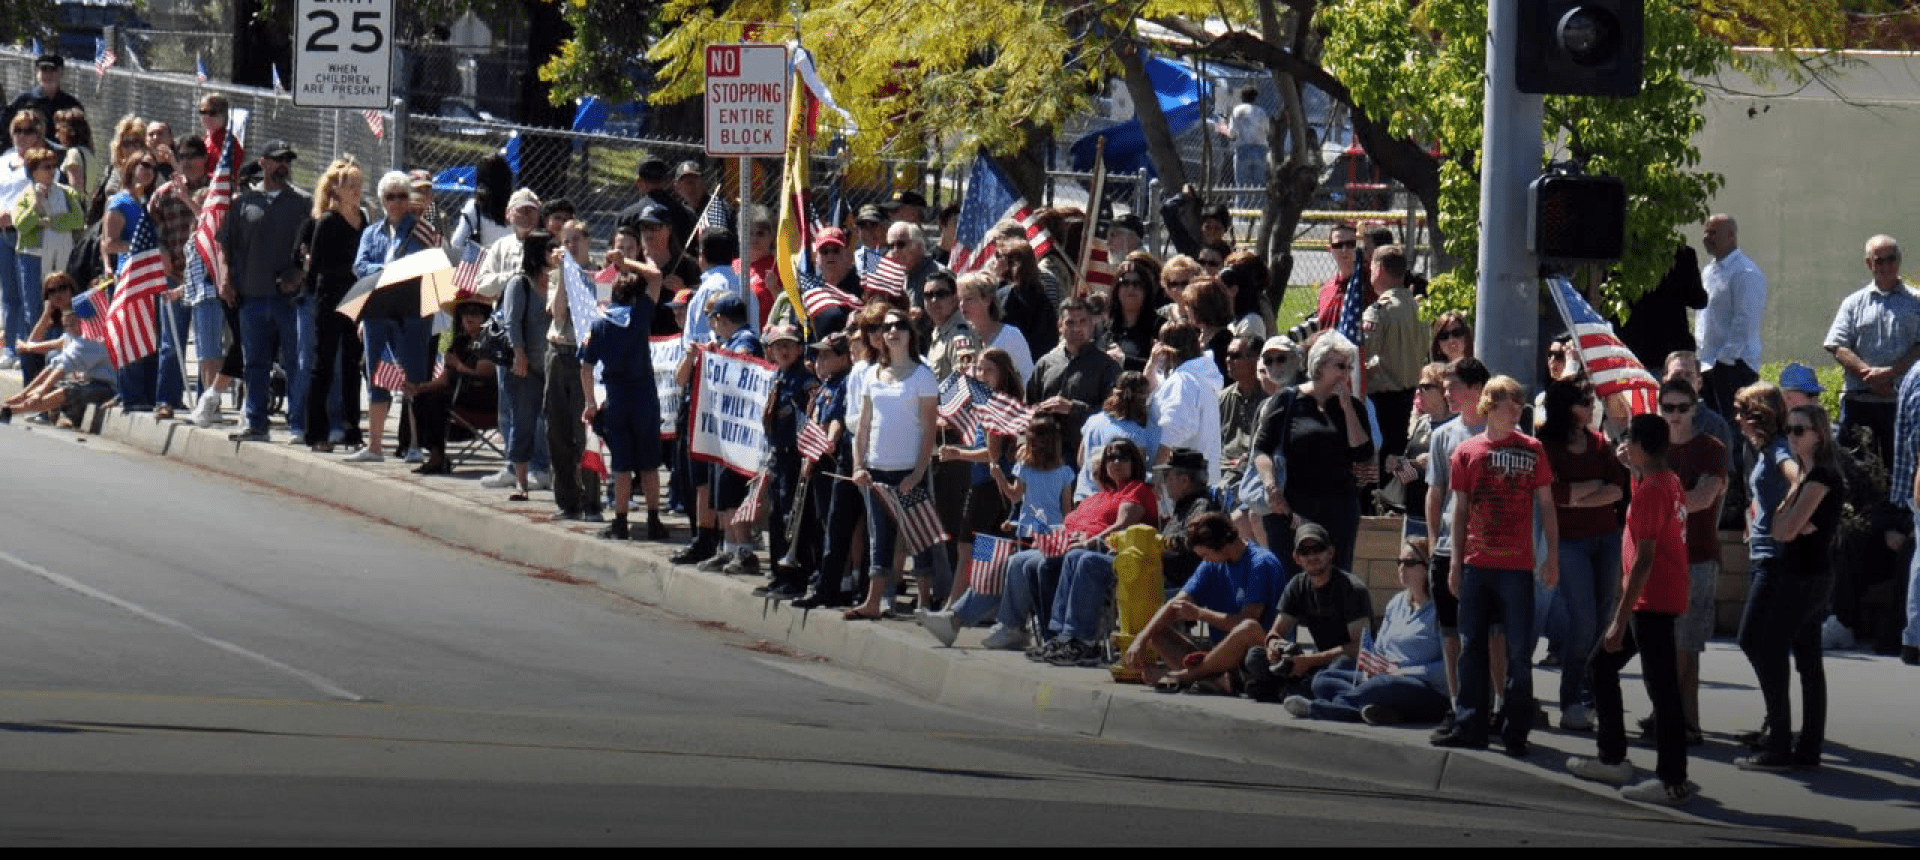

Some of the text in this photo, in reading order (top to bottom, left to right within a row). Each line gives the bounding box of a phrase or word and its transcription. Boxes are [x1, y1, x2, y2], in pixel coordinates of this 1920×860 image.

[305, 9, 384, 54] 25
[328, 63, 357, 74] WHEN
[711, 50, 735, 73] NO
[315, 73, 370, 84] CHILDREN
[302, 83, 381, 95] ARE PRESENT
[712, 83, 781, 103] STOPPING
[719, 109, 774, 124] ENTIRE
[721, 128, 772, 144] BLOCK
